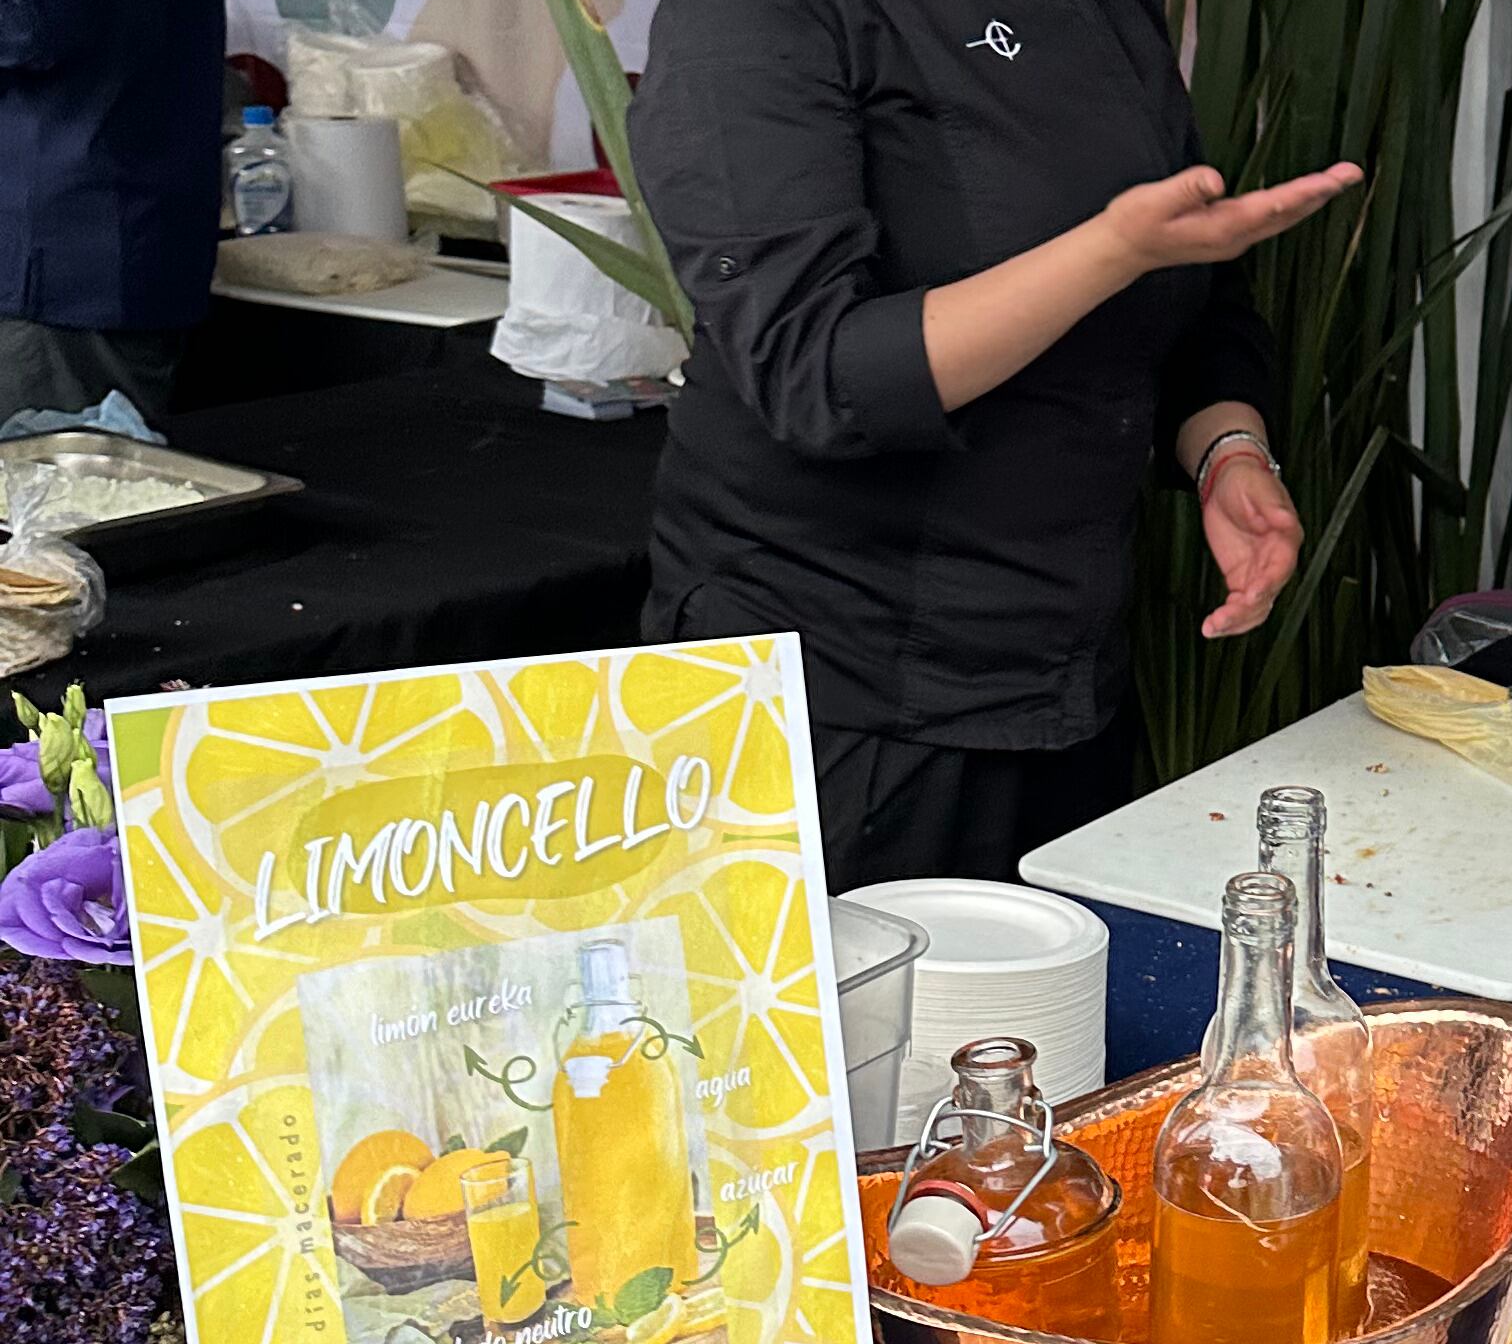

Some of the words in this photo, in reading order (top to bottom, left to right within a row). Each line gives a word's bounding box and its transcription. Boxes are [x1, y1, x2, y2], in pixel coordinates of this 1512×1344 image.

[254, 755, 711, 941] LIMONCELLO
[371, 999, 437, 1046] limón
[447, 978, 532, 1026] eureka
[695, 1066, 751, 1107] agua
[279, 1113, 316, 1255] macerado
[720, 1161, 800, 1202] azúcar
[304, 1271, 327, 1332] días
